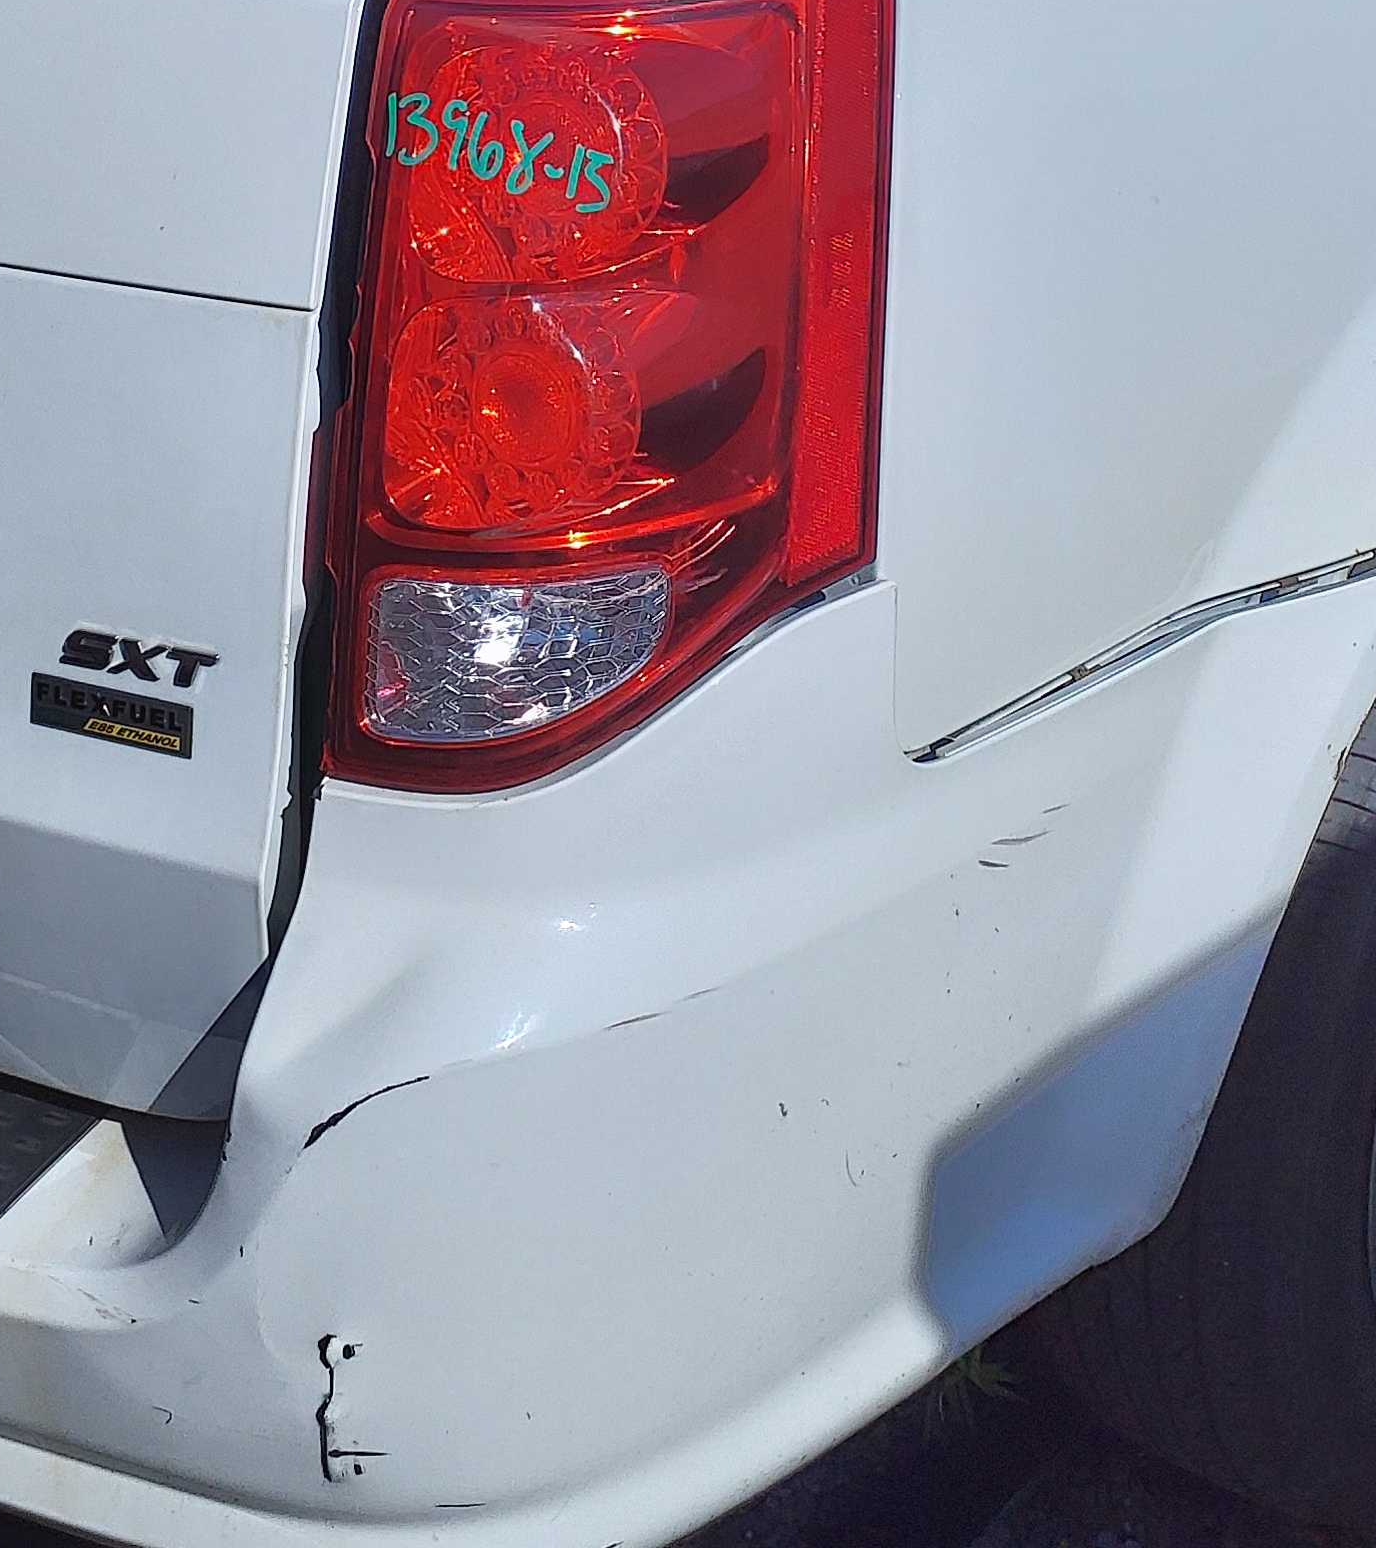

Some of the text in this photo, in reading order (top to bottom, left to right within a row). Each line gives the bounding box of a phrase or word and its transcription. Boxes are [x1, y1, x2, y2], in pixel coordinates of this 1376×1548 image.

[385, 92, 615, 214] 13968-15
[58, 628, 221, 688] SXT
[87, 718, 178, 749] E85 ETHANOL
